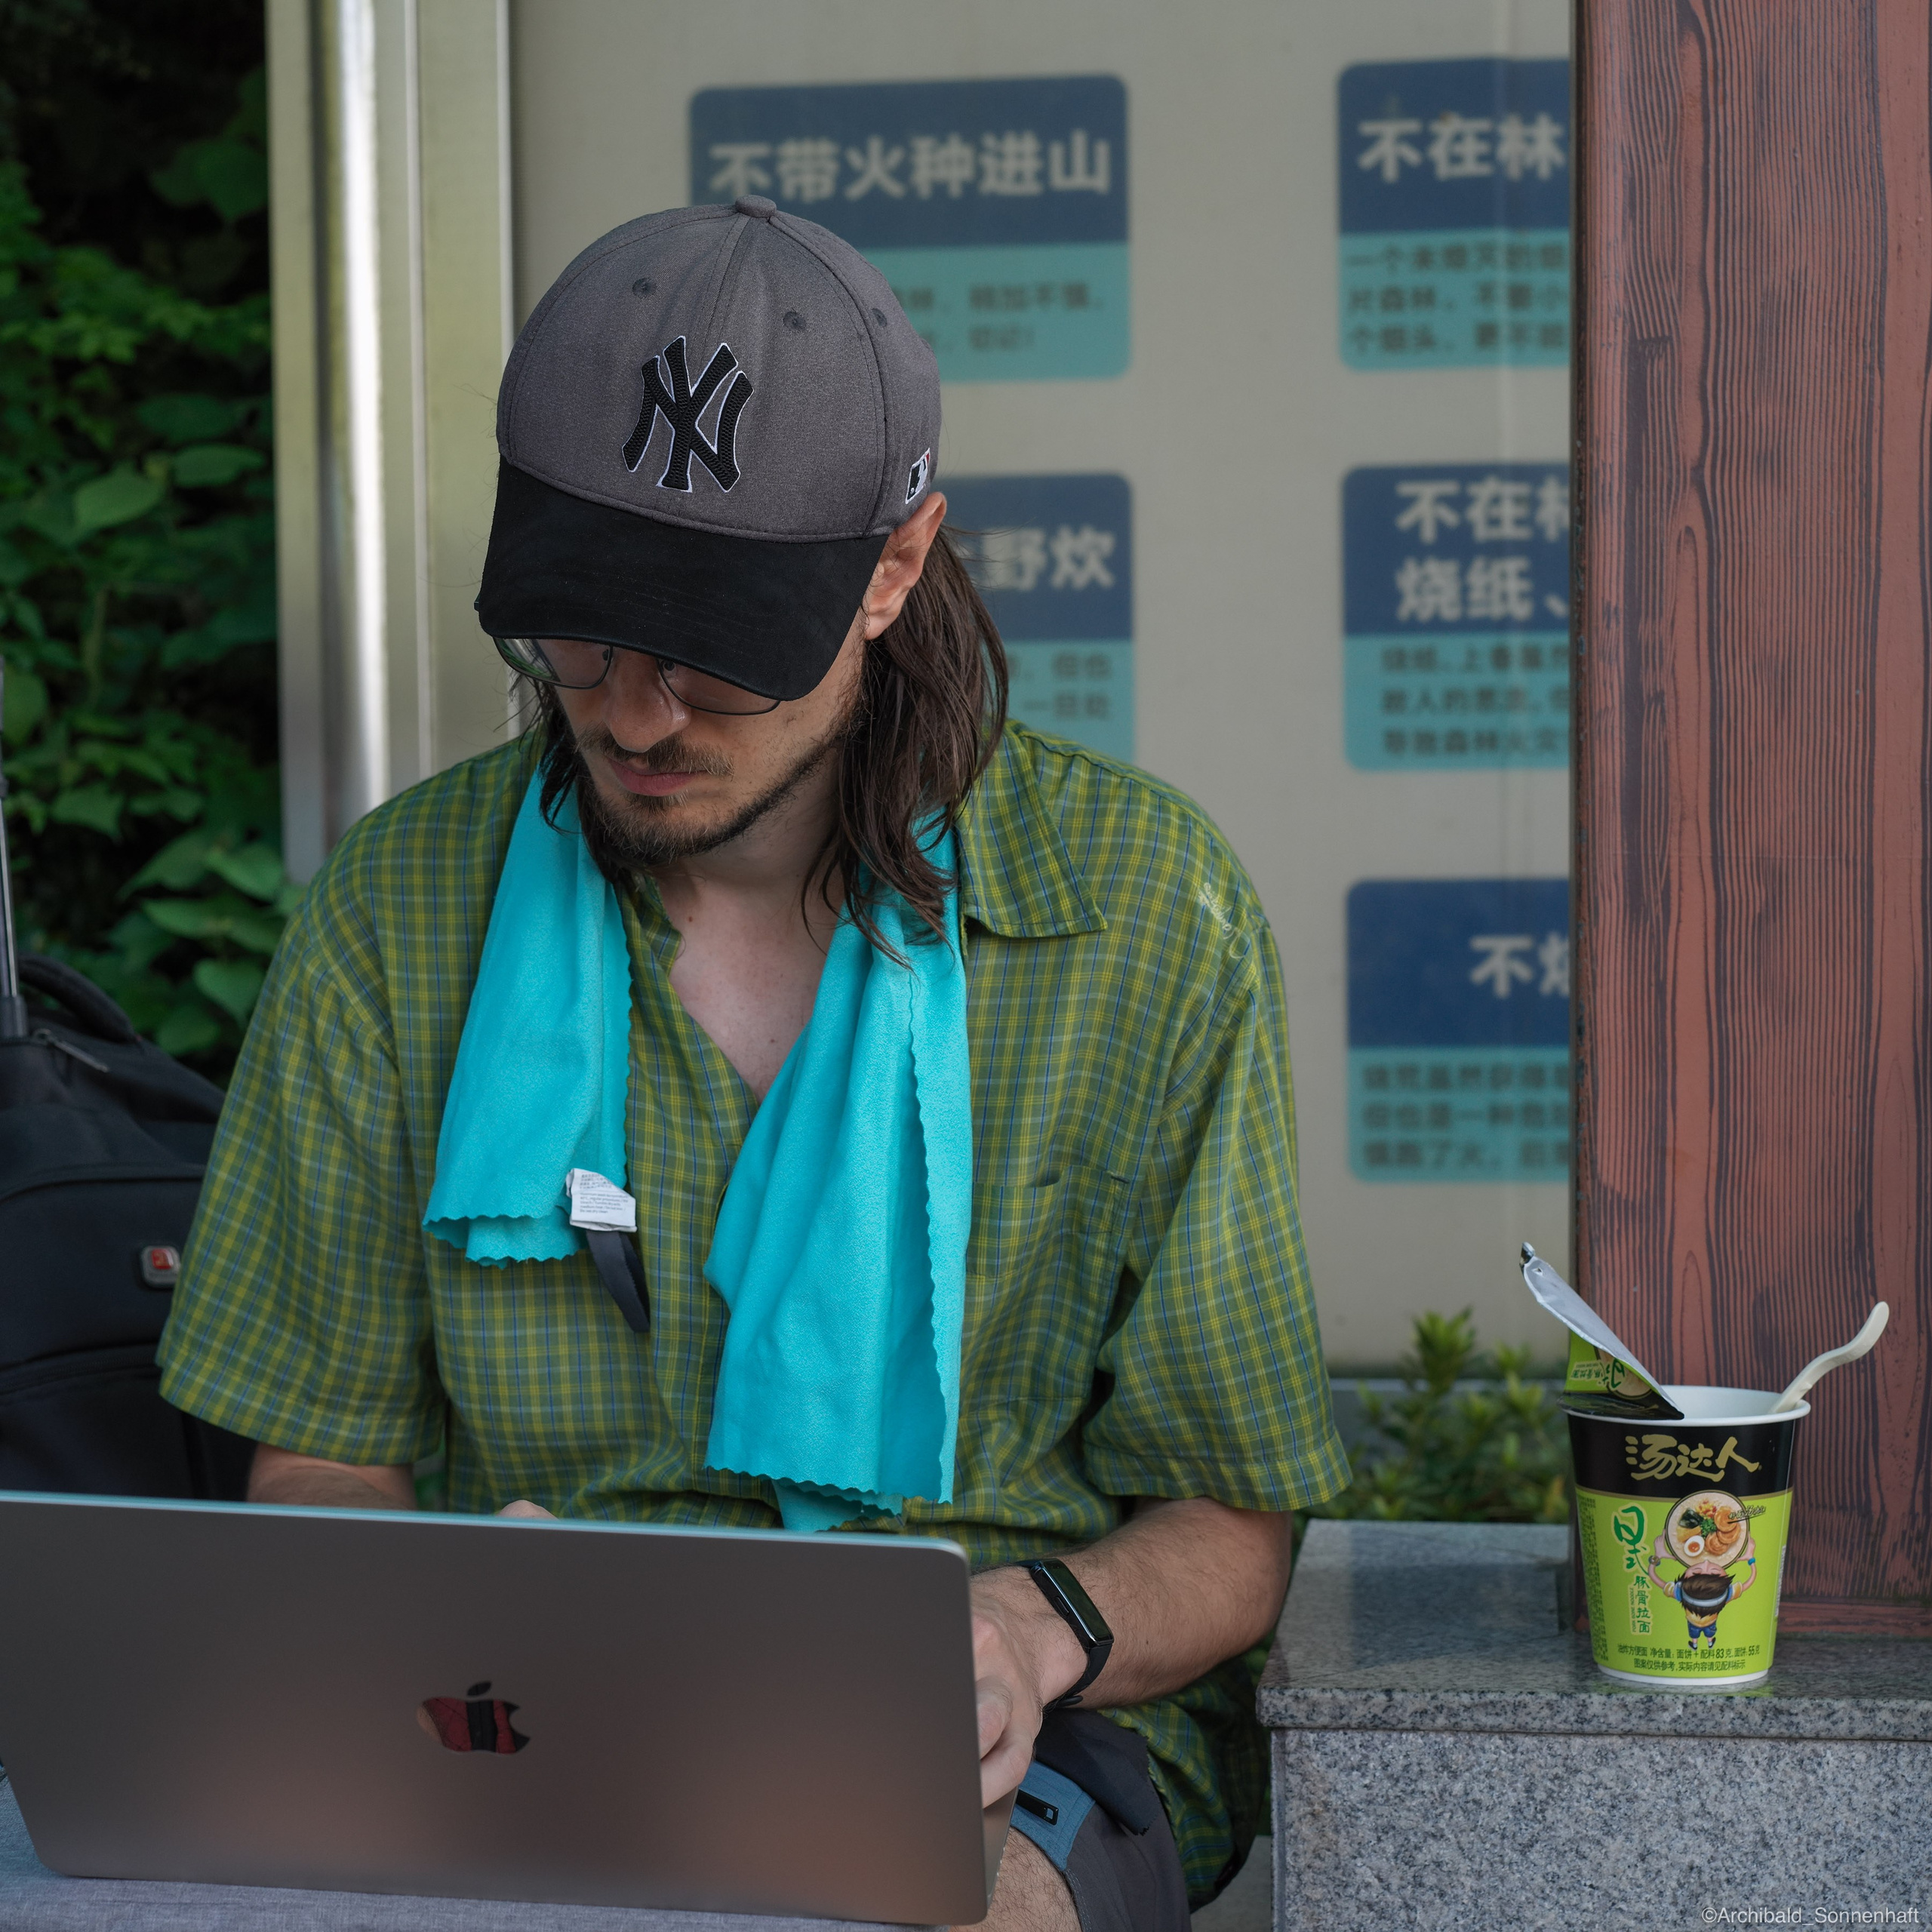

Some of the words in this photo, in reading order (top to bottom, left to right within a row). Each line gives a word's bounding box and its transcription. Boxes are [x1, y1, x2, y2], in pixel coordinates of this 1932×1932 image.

[708, 128, 1110, 203] 不带火种进山
[1358, 111, 1564, 183] 不在林
[622, 335, 754, 493] NY
[1625, 1434, 1759, 1483] 汤达人
[1614, 1506, 1649, 1577] 日式
[1633, 1575, 1651, 1634] 豚骨拉面
